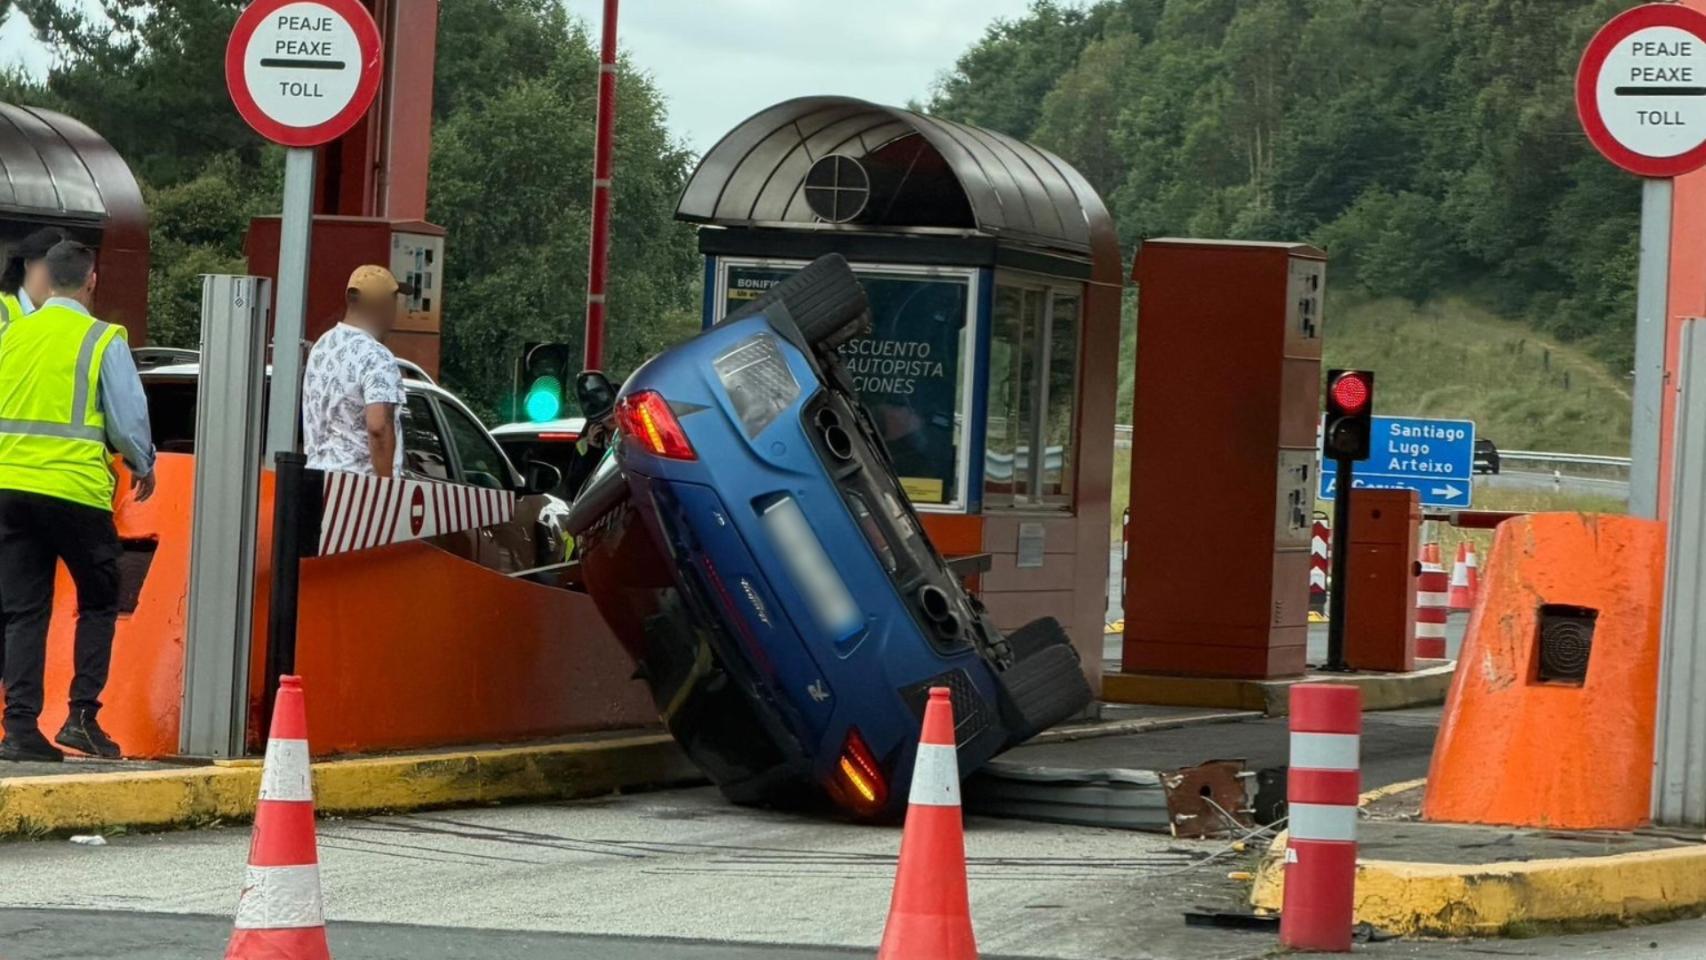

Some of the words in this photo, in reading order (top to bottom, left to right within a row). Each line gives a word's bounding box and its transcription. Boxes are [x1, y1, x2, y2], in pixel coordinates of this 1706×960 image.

[278, 16, 332, 32] PEAJE
[275, 40, 332, 56] PEAXE
[1632, 42, 1692, 56] PEAJE
[1631, 67, 1692, 82] PEAXE
[279, 82, 323, 97] TOLL
[1637, 111, 1685, 125] TOLL
[837, 339, 930, 358] ESCUENTO
[847, 358, 944, 377] AUTOPISTA
[852, 376, 915, 394] CIONES
[1390, 423, 1465, 441] Santiago
[1388, 440, 1430, 456] Lugo
[1388, 458, 1453, 473] Arteixo
